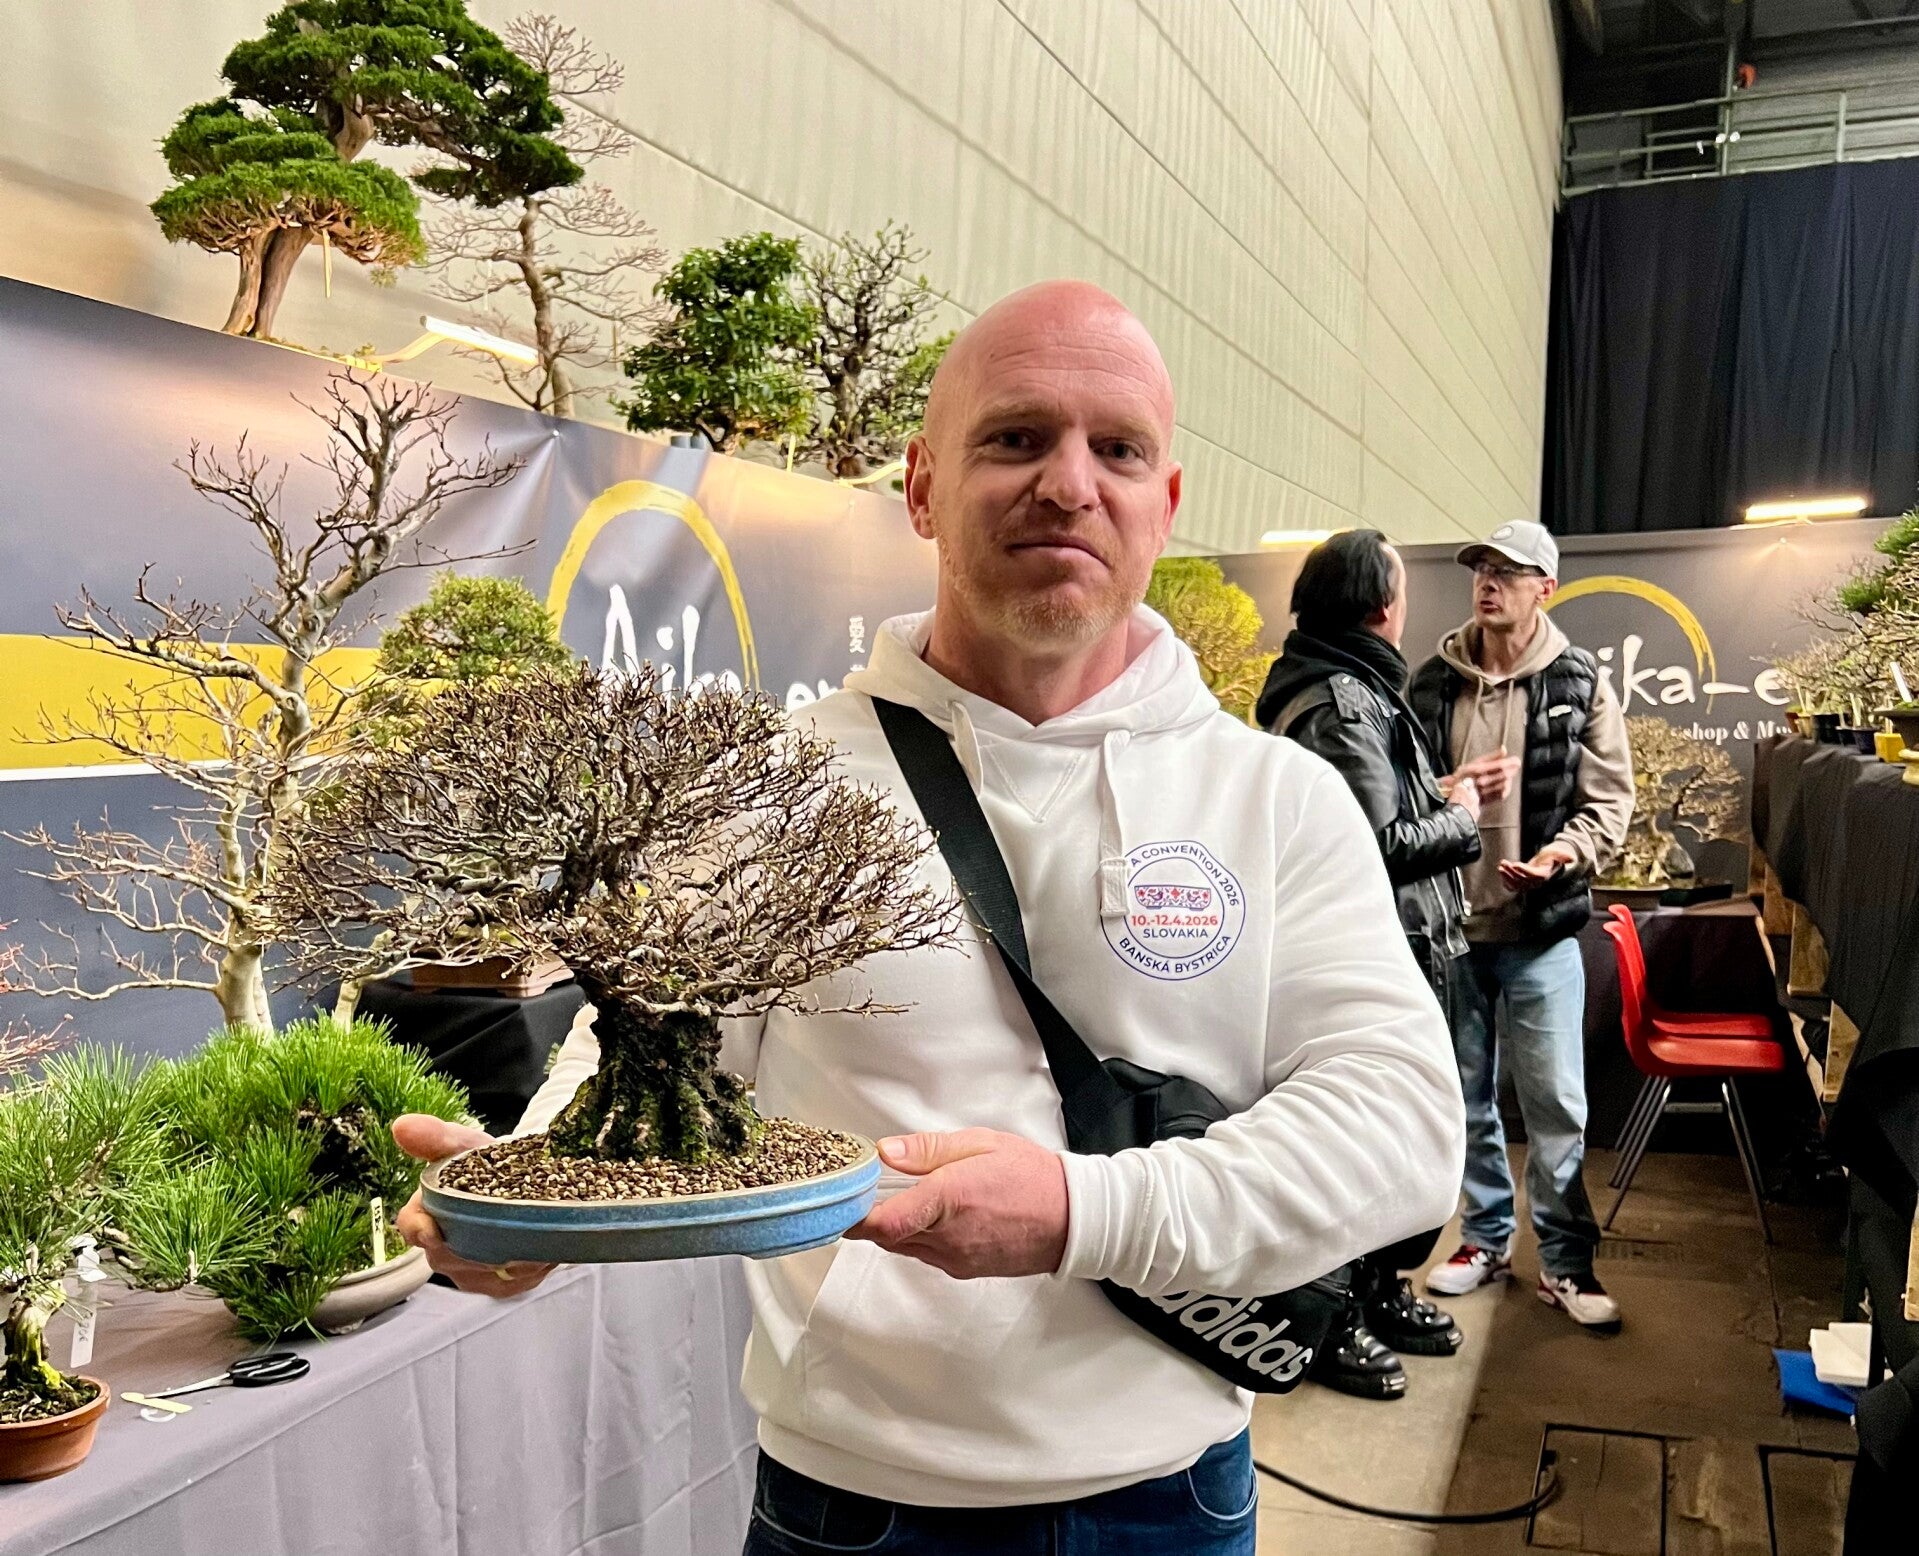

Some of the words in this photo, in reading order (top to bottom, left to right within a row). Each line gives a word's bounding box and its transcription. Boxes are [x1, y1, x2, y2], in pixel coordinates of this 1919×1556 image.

[1671, 721, 1729, 746] shop
[1733, 720, 1751, 740] &
[1142, 845, 1221, 879] CONVENTION
[1219, 877, 1239, 907] 2026
[1131, 914, 1218, 927] 10.-12.4.2026
[1143, 928, 1209, 939] SLOVAKIA
[1119, 937, 1170, 974] BANSKÁ
[1175, 935, 1231, 973] BYSTRICA
